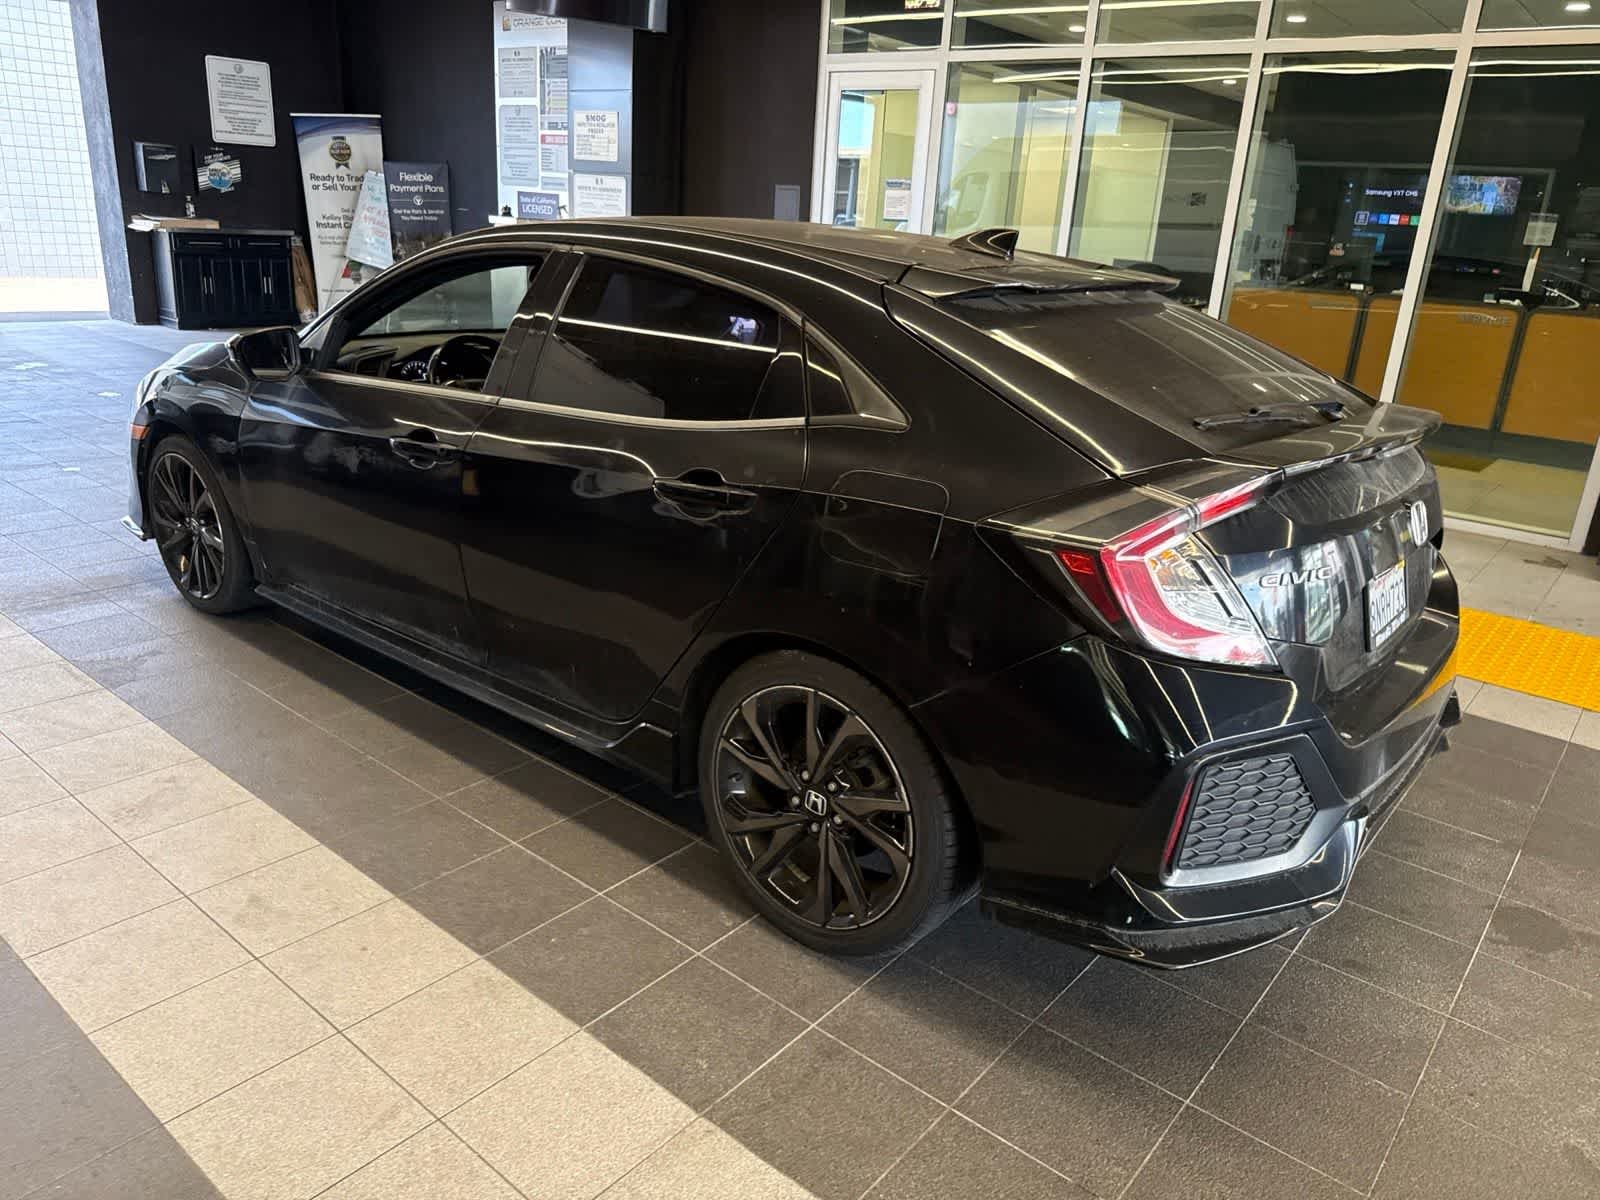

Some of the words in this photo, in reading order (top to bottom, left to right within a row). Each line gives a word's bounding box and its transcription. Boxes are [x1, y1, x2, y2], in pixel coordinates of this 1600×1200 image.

[585, 114, 607, 122] SMOG
[310, 172, 335, 183] Ready
[336, 174, 345, 182] to
[346, 173, 364, 182] Trad
[399, 171, 434, 182] Flexible
[321, 182, 338, 191] Sell
[339, 183, 357, 192] Your
[390, 183, 424, 193] Payment
[424, 184, 445, 193] Plans
[1365, 188, 1393, 198] Samsung
[522, 203, 553, 215] LICENSED
[315, 220, 343, 230] Instant
[1259, 566, 1333, 588] CIVIC
